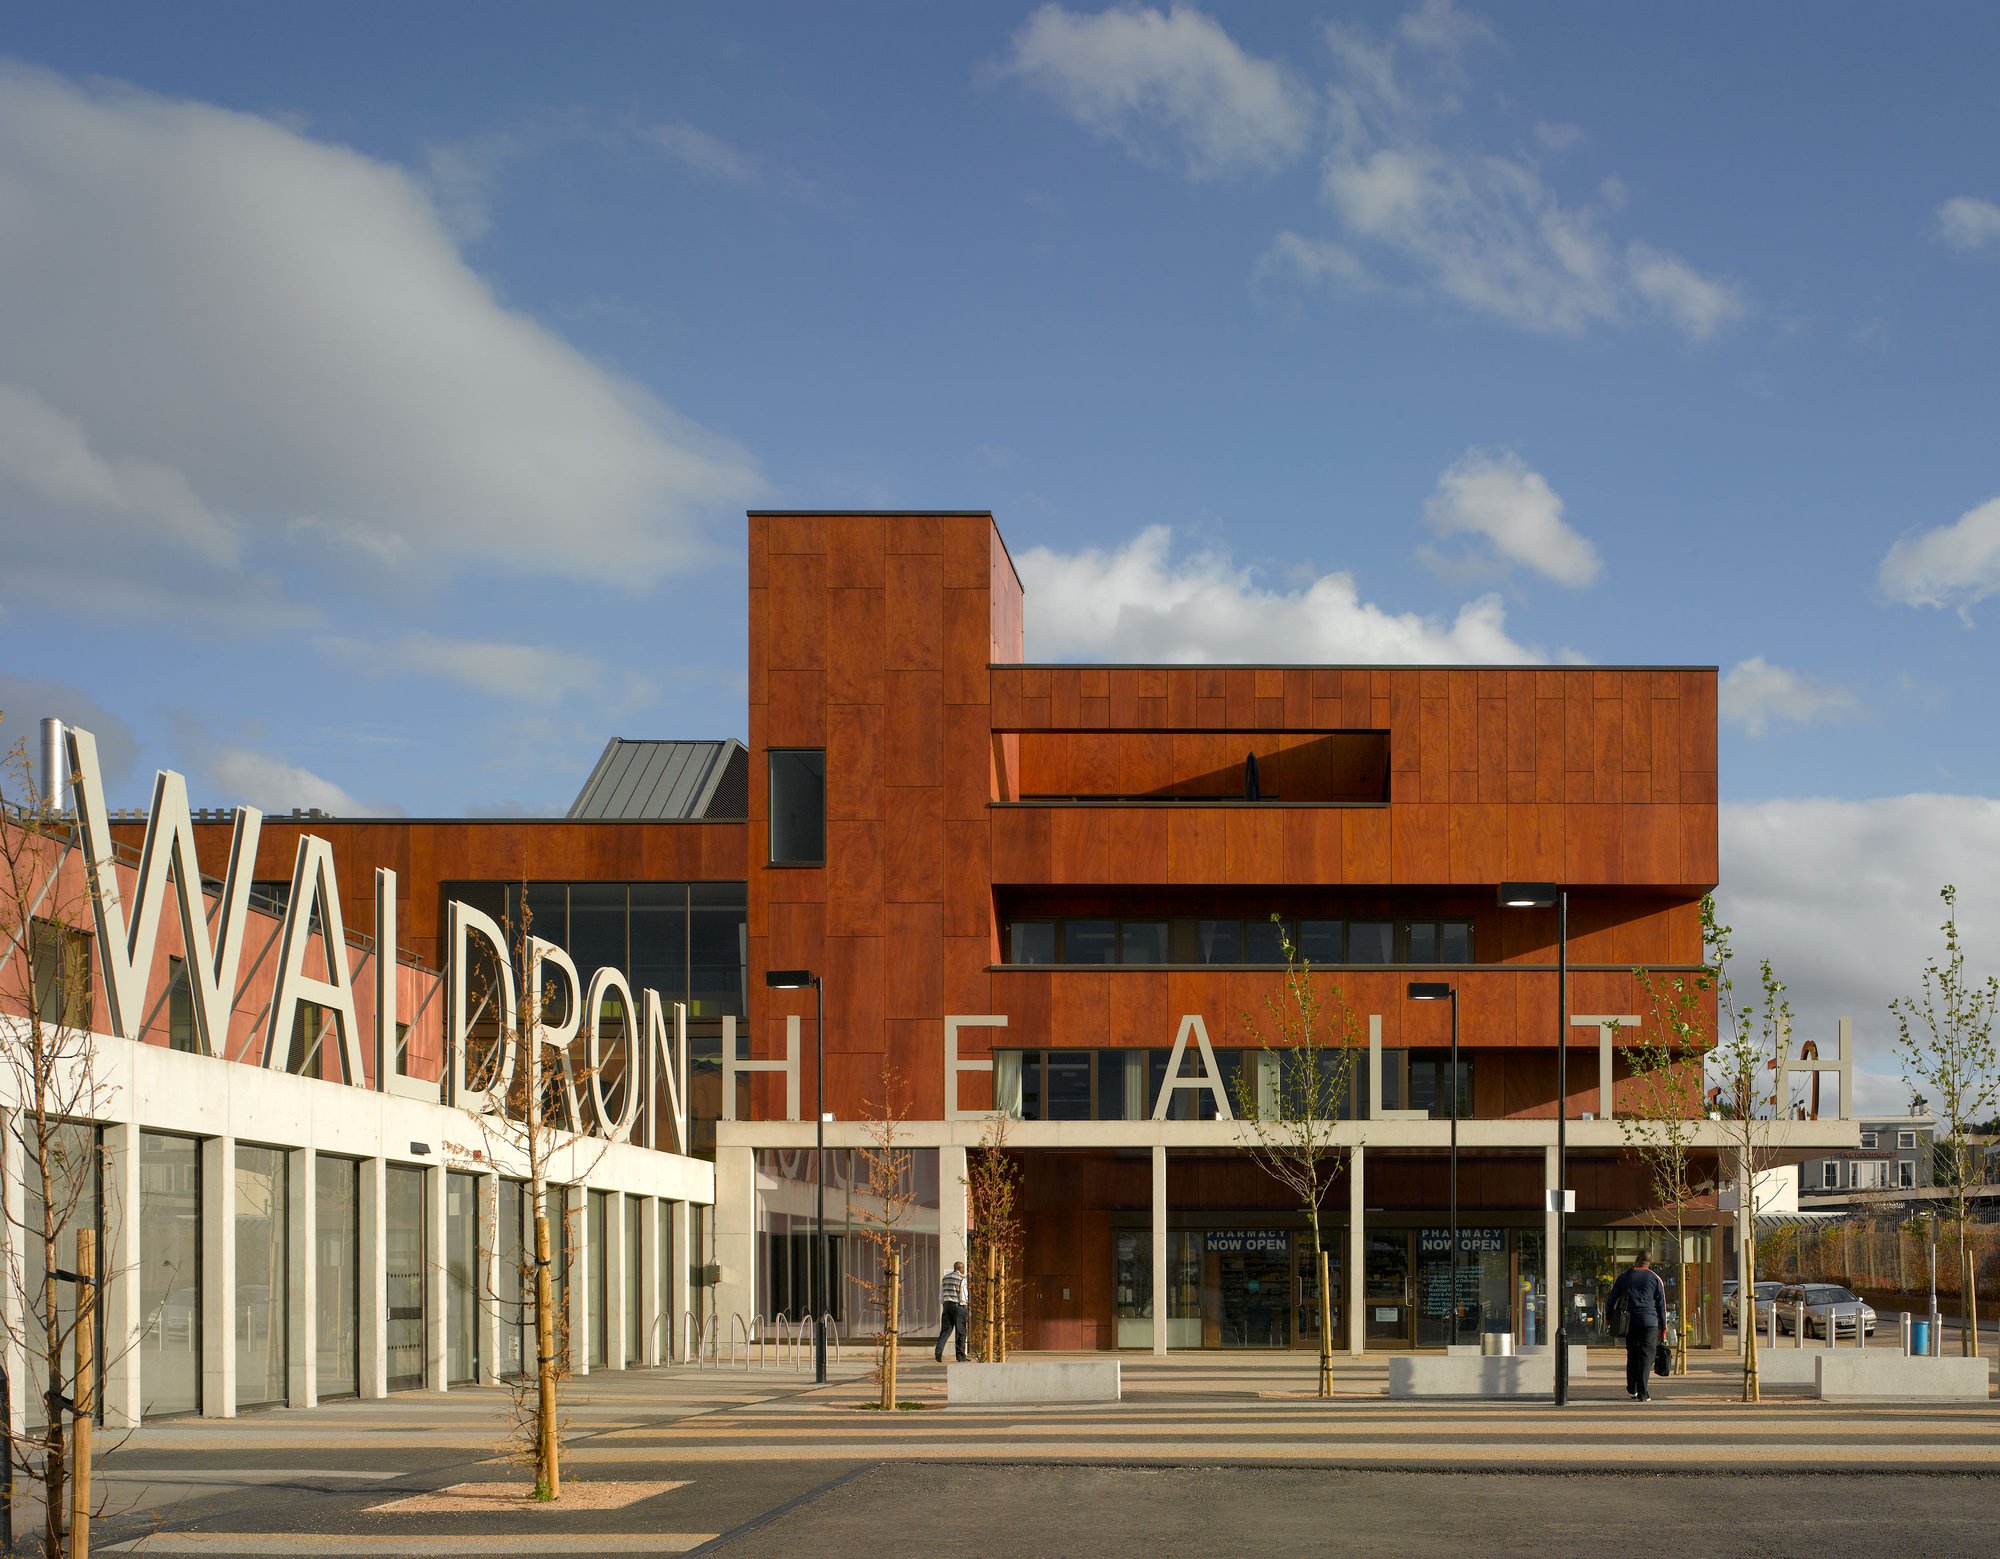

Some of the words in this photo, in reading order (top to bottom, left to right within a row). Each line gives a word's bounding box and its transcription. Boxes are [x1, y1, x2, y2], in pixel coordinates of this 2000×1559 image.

[64, 726, 687, 1157] WALDRON
[722, 1014, 1852, 1121] HEALTH
[1207, 1230, 1286, 1238] PHARMACY
[1207, 1239, 1242, 1250] NOW
[1246, 1239, 1286, 1250] OPEN
[1422, 1239, 1453, 1250] NOW
[1461, 1239, 1501, 1250] OPEN
